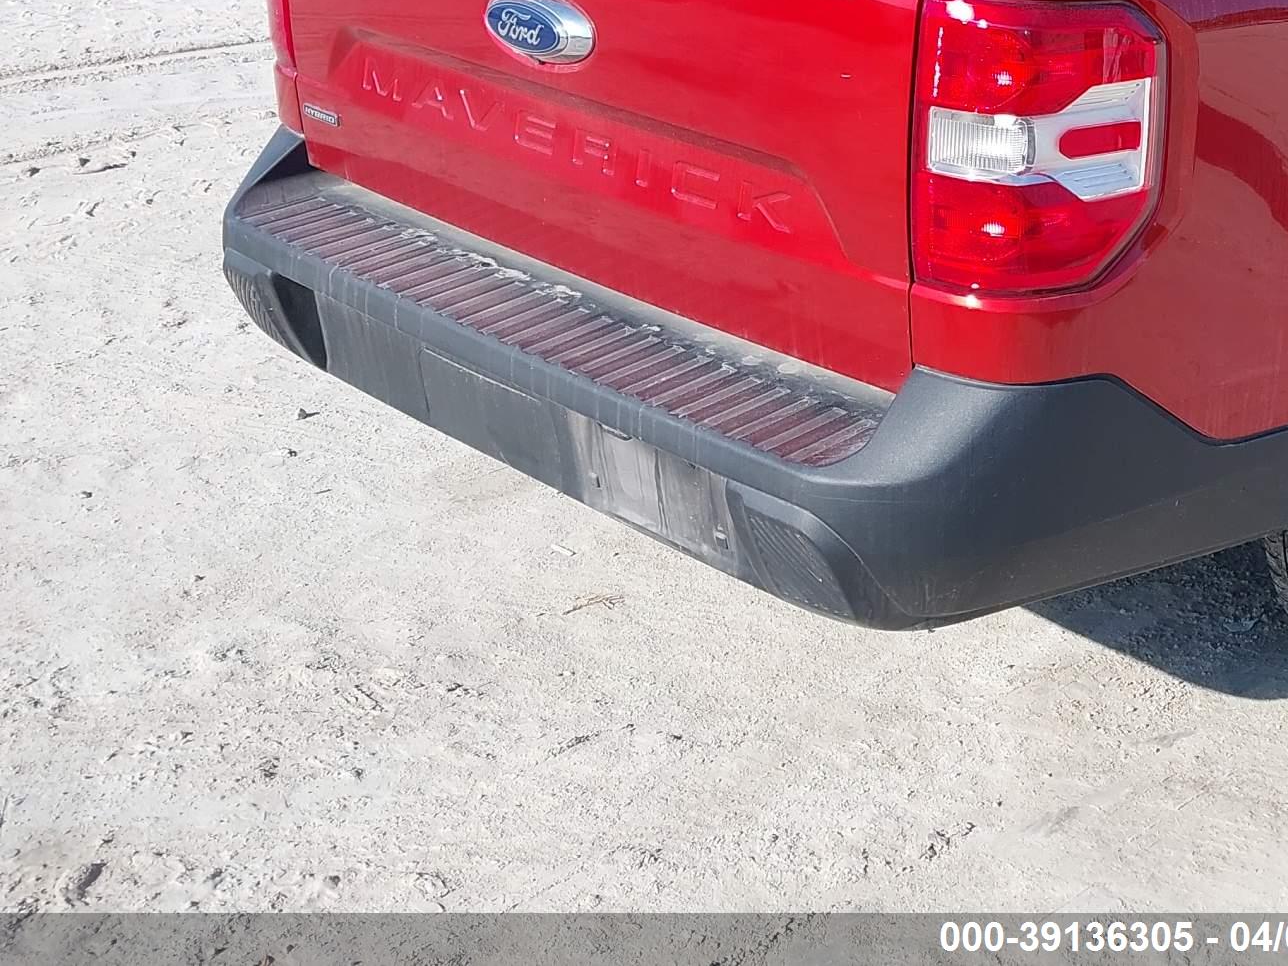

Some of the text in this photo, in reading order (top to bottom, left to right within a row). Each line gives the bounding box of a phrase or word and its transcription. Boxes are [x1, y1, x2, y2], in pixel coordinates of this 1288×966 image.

[497, 7, 544, 46] Ford
[304, 106, 336, 125] HYBRID
[361, 54, 792, 235] MAVERICK
